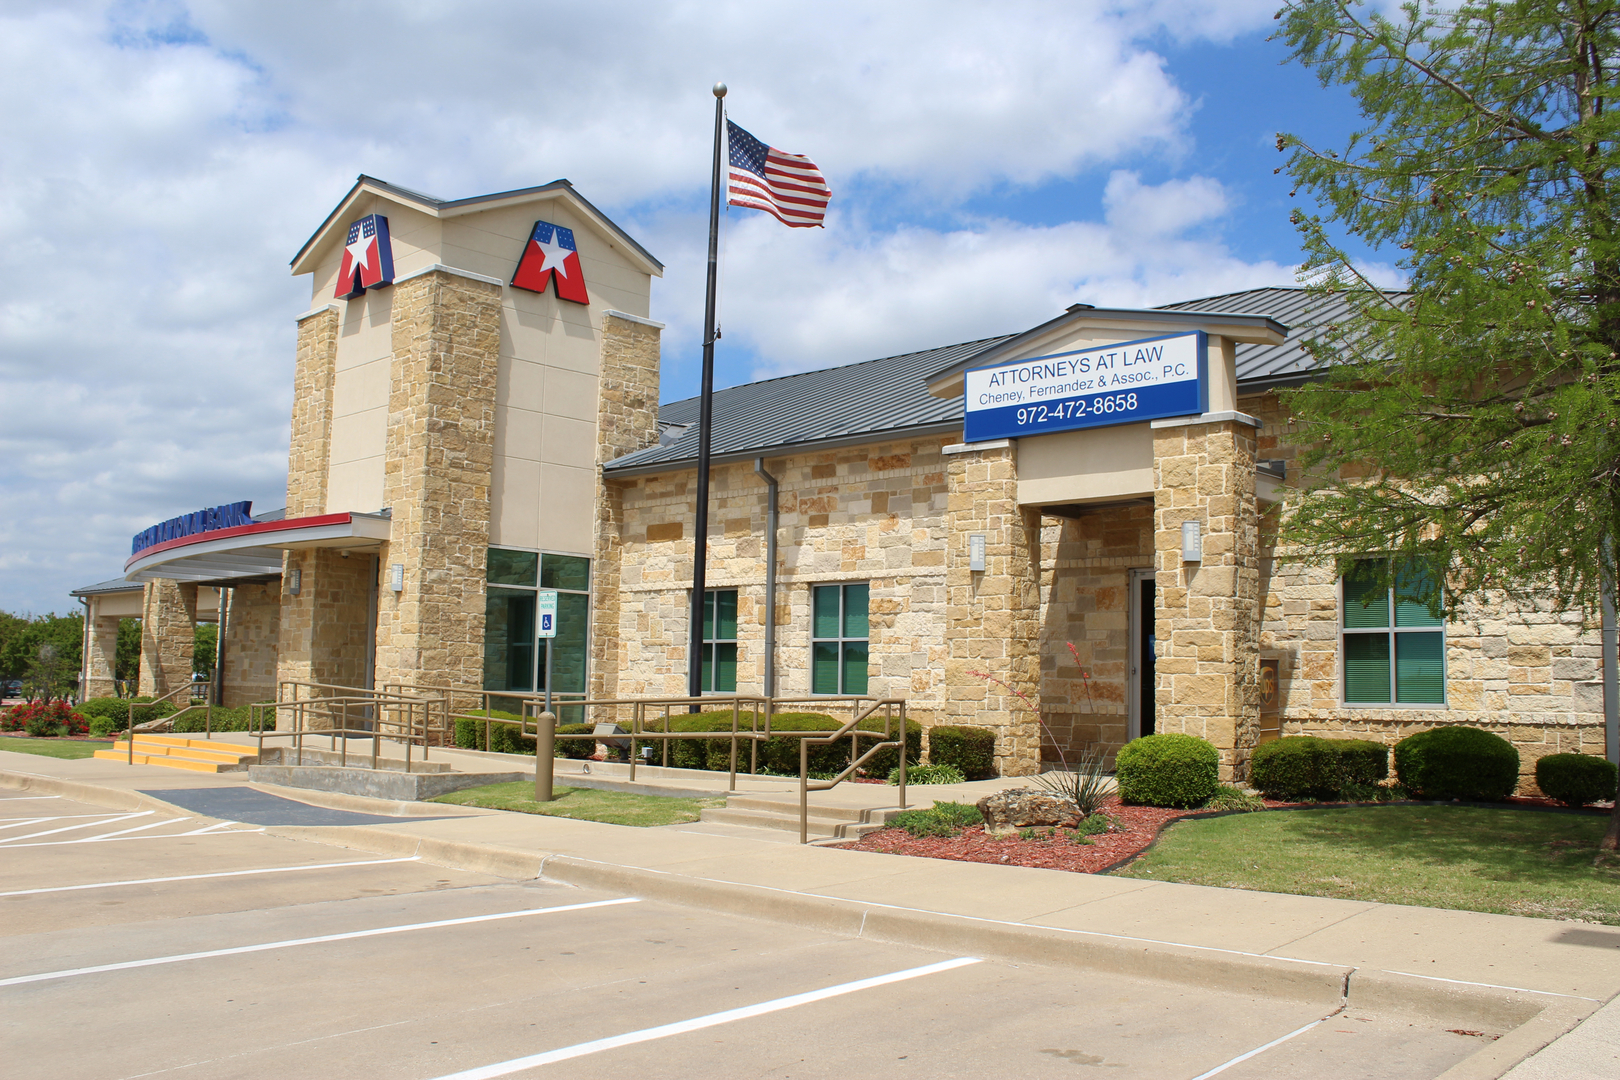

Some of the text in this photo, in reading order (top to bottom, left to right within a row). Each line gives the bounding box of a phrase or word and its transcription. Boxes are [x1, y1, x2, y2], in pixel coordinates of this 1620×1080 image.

[979, 362, 1189, 405] Cheney, Fernandez & Assoc., P.C.
[988, 345, 1164, 388] ATTORNEYS AT LAW
[1016, 392, 1138, 425] 972-472-8658
[207, 500, 252, 531] BANK
